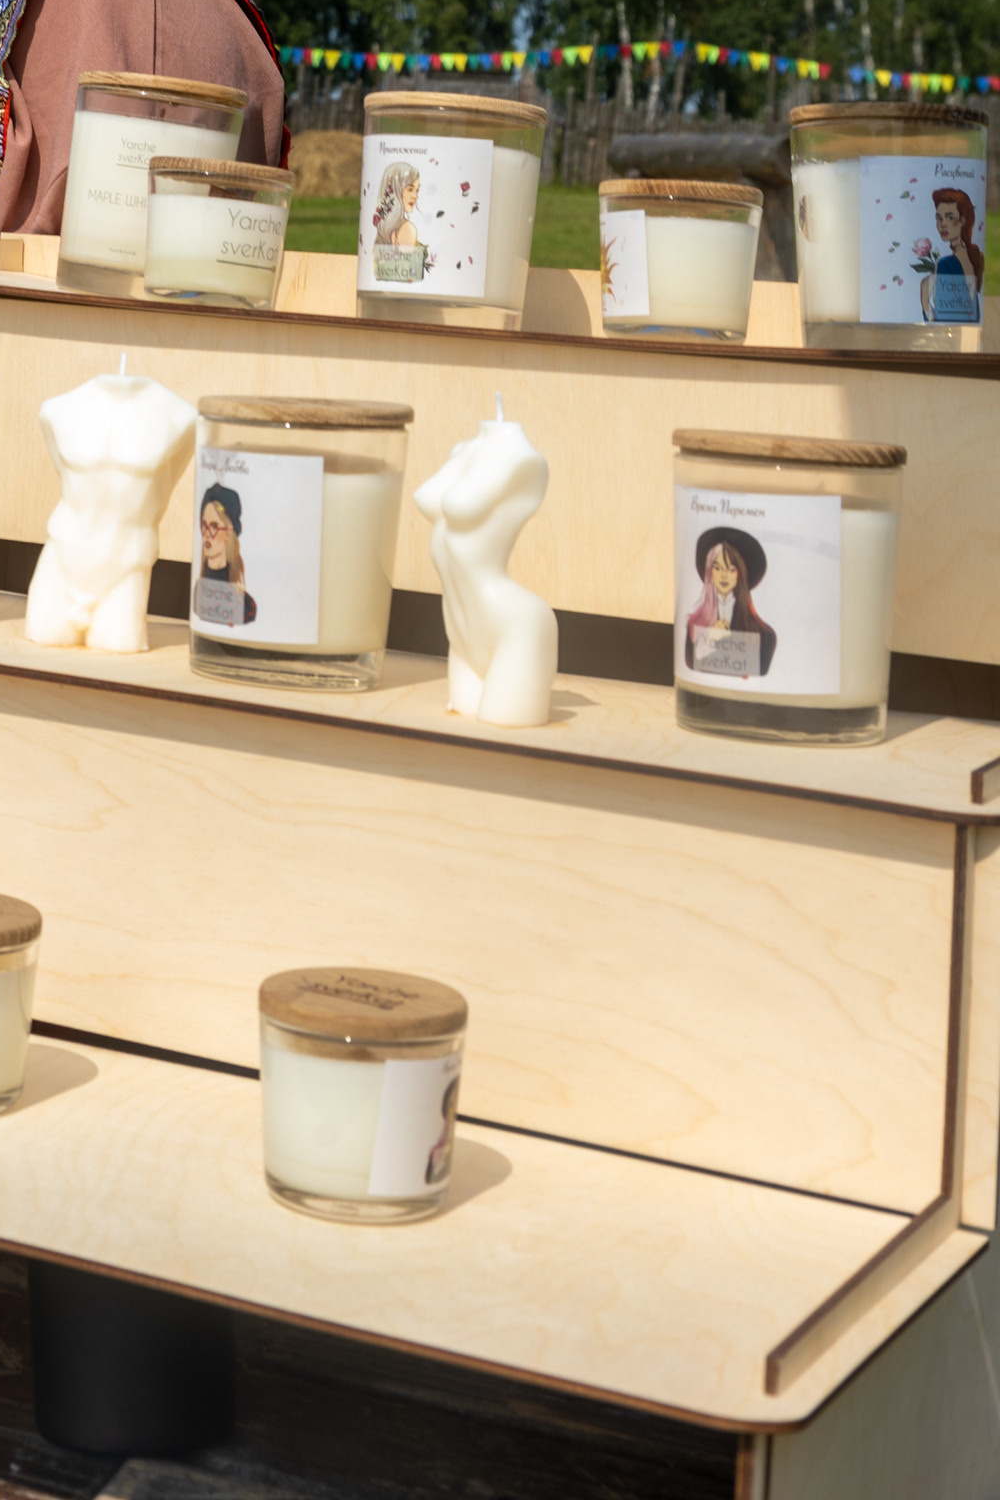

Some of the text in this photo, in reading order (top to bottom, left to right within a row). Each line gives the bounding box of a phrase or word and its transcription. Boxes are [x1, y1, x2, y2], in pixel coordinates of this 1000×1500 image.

[121, 138, 156, 152] Yarche
[118, 153, 149, 166] sverKa
[934, 162, 975, 180] Расцветай
[88, 188, 147, 209] MAPLE WHI
[228, 206, 282, 236] Yarche
[690, 495, 765, 518] Время Перемен
